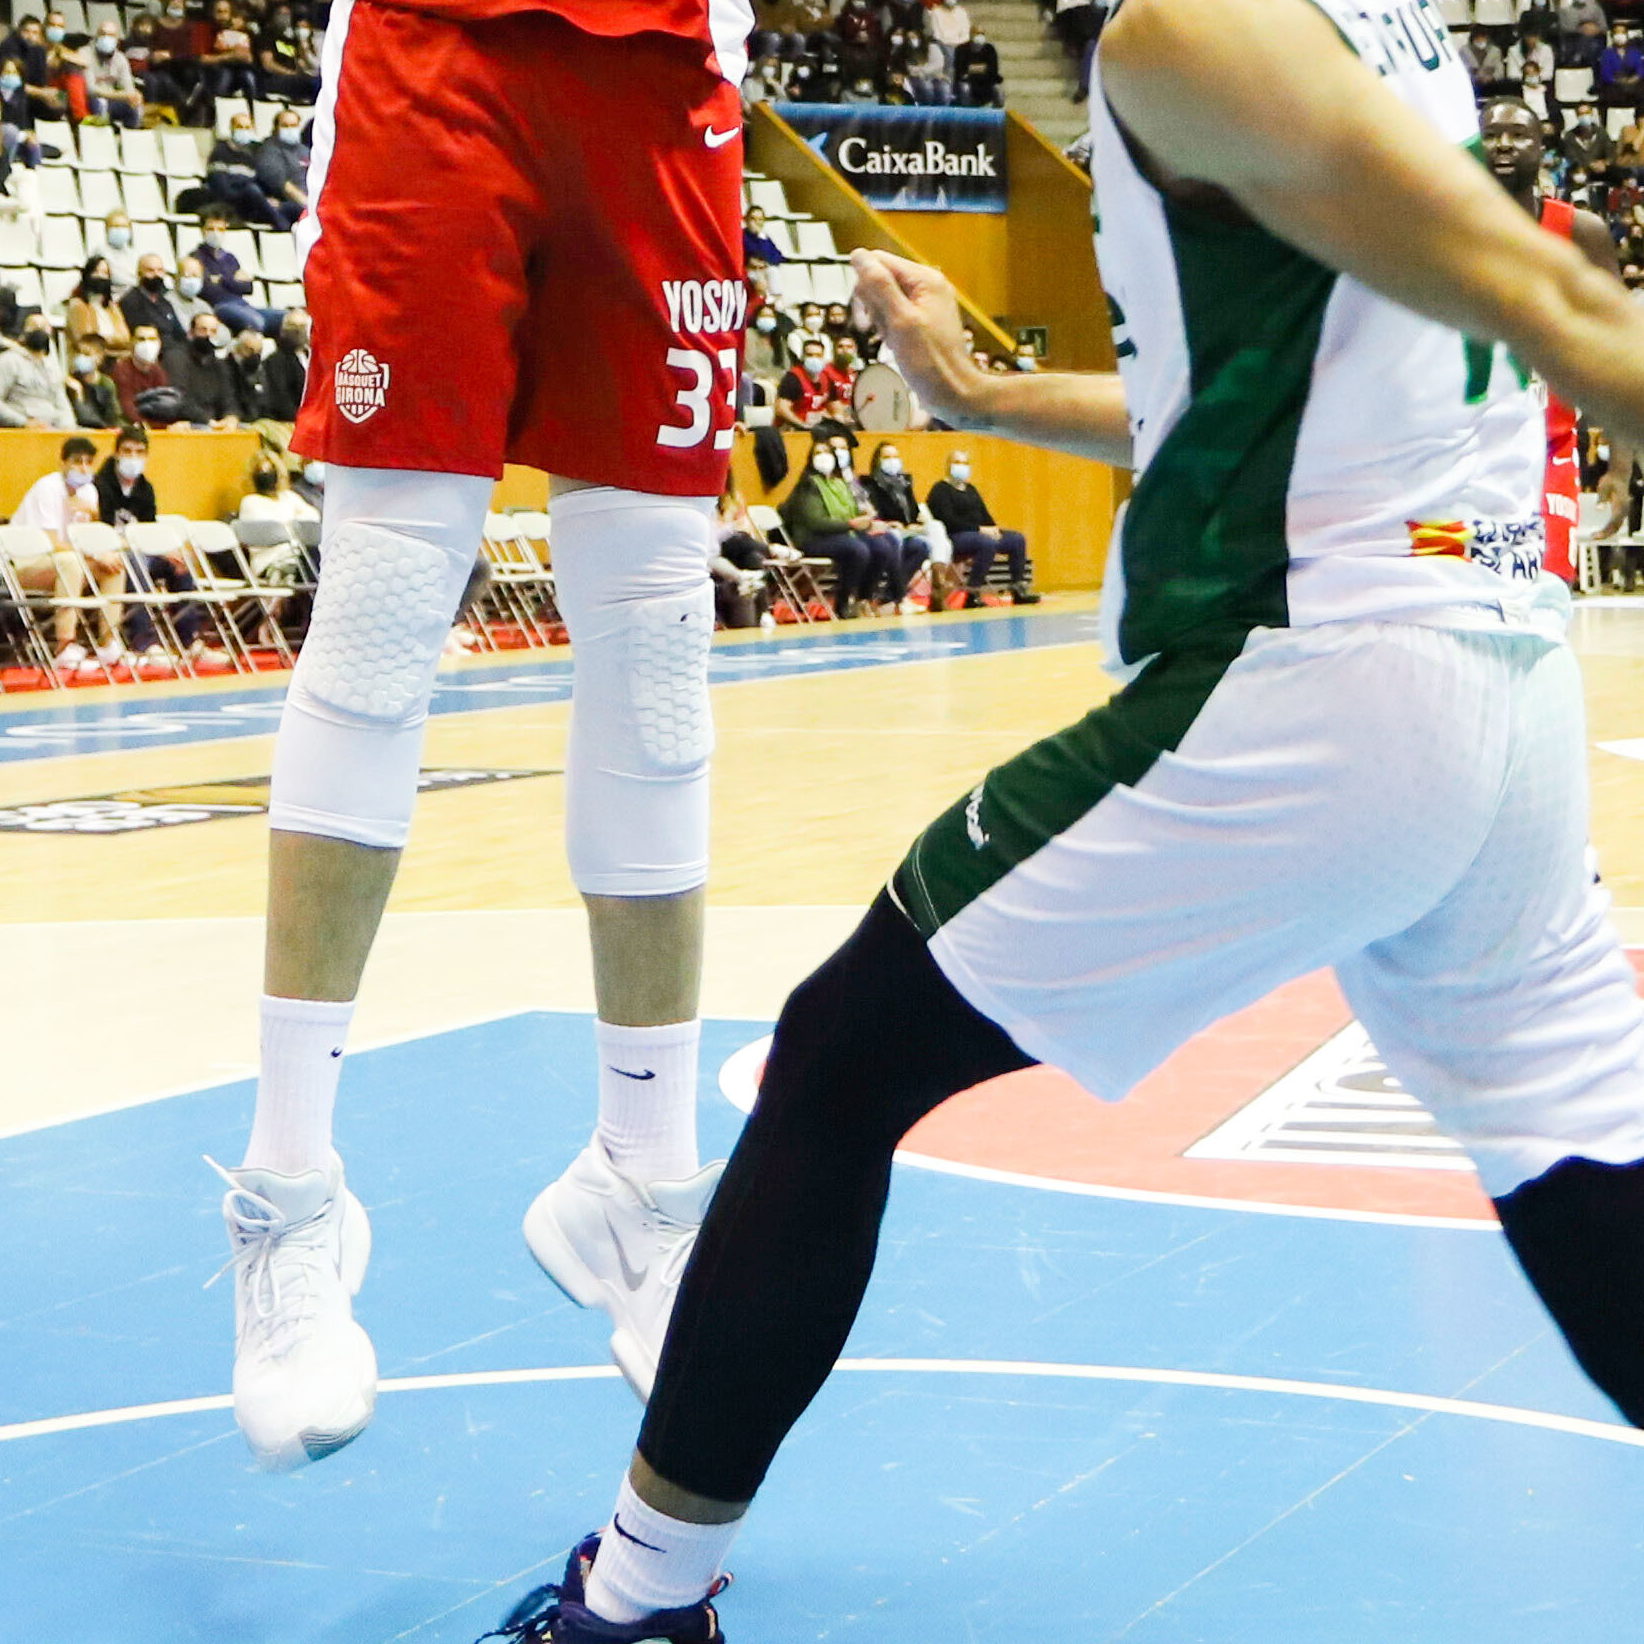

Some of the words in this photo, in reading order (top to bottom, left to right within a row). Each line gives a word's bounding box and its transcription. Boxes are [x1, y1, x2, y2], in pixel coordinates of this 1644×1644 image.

[837, 136, 997, 178] CaixaBank
[661, 279, 748, 335] YOSOY
[335, 386, 386, 407] GIRONA
